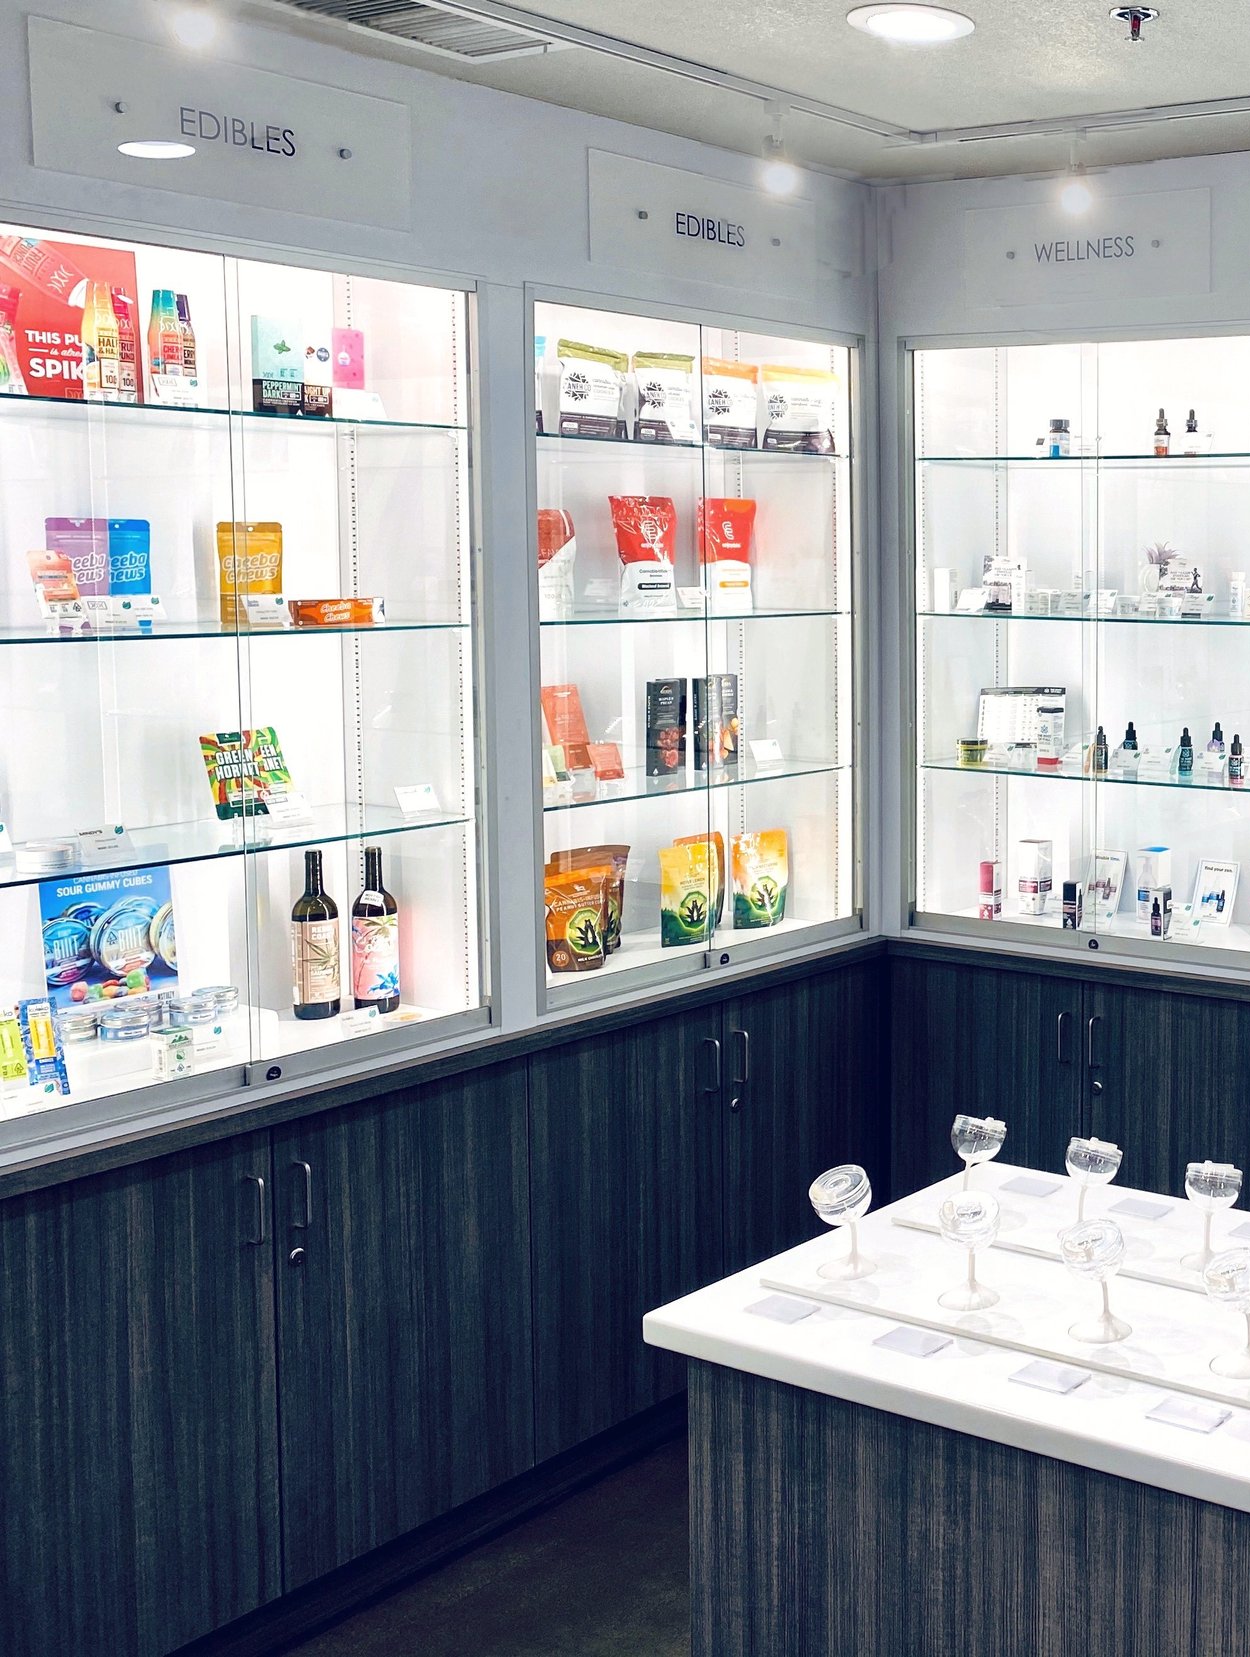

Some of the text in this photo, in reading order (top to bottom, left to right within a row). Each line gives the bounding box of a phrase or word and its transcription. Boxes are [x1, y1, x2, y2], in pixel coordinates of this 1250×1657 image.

[179, 106, 297, 158] EDIBLES
[675, 211, 746, 248] EDIBLES
[1034, 235, 1136, 263] WELLNESS
[24, 329, 84, 347] THIS PU
[28, 357, 85, 381] SPIK
[262, 380, 302, 392] PEPPERMINT
[262, 390, 281, 399] DARK
[215, 749, 254, 765] GREEN
[56, 874, 153, 898] SOUR GUMMY CUBES
